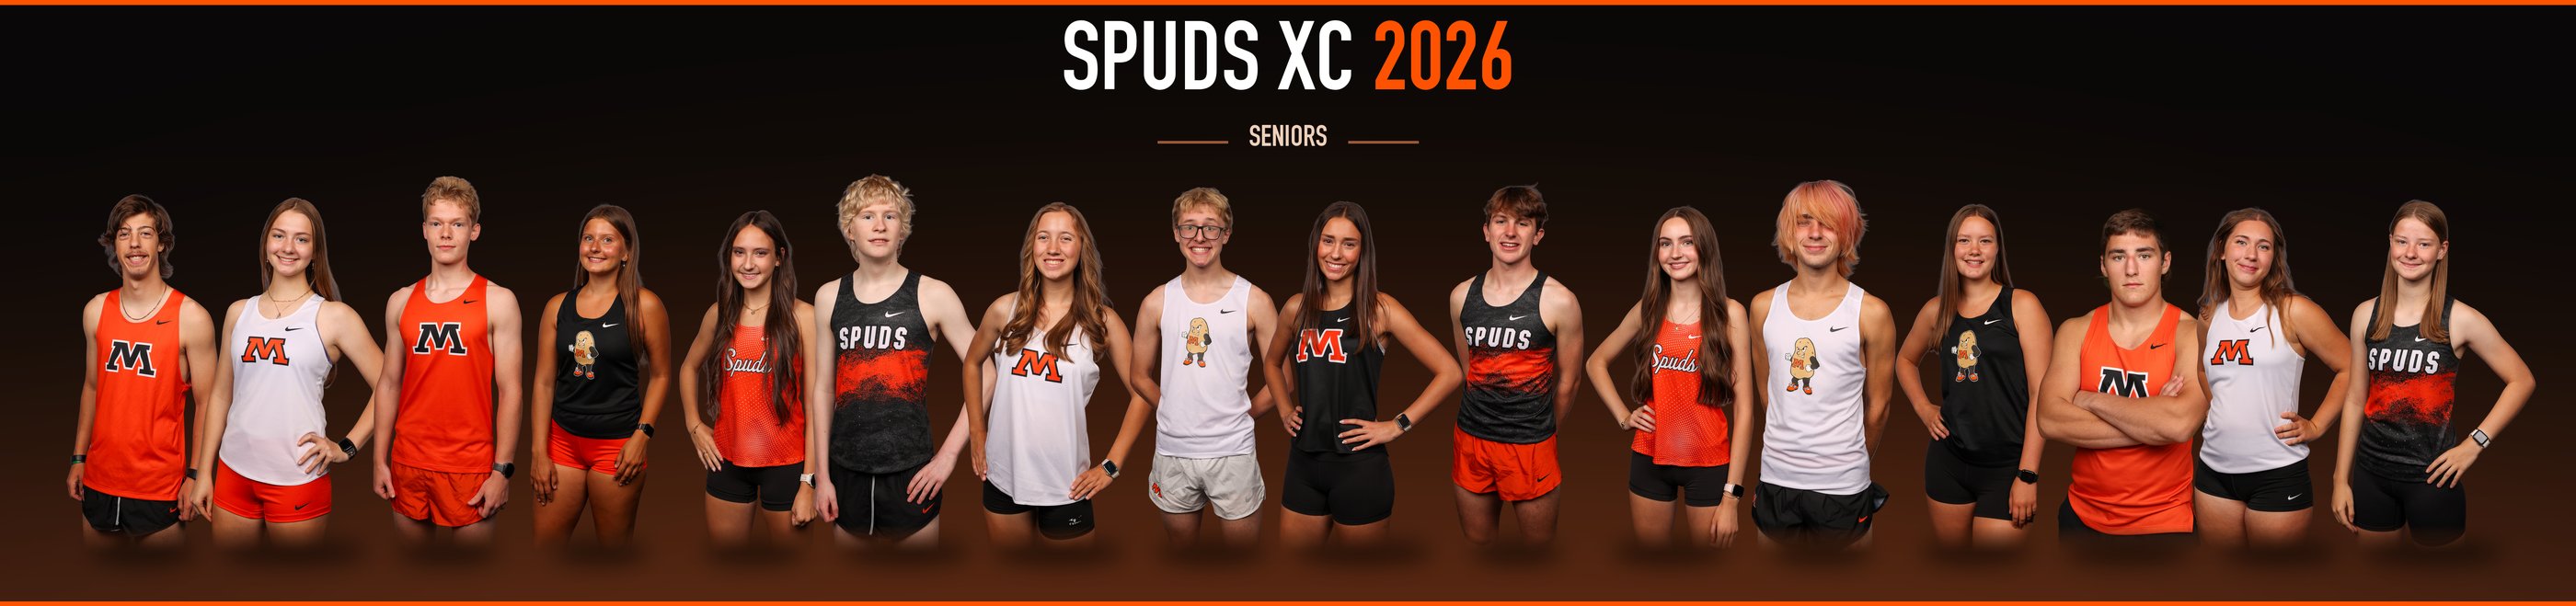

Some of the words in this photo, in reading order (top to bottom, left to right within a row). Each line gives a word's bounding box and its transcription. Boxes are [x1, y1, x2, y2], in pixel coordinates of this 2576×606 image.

[241, 337, 290, 366] M
[413, 322, 467, 356] M
[839, 326, 908, 350] SPUDS
[1188, 336, 1199, 346] M
[1296, 328, 1348, 362] M
[1465, 326, 1532, 350] SPUDS
[106, 339, 156, 378] M
[575, 349, 586, 358] M
[1011, 349, 1063, 383] M
[1651, 344, 1699, 375] Spuds
[1791, 358, 1804, 370] M
[1958, 349, 1969, 360] M
[2211, 339, 2254, 366] M
[2368, 349, 2440, 375] SPUDS
[2099, 366, 2150, 398] M
